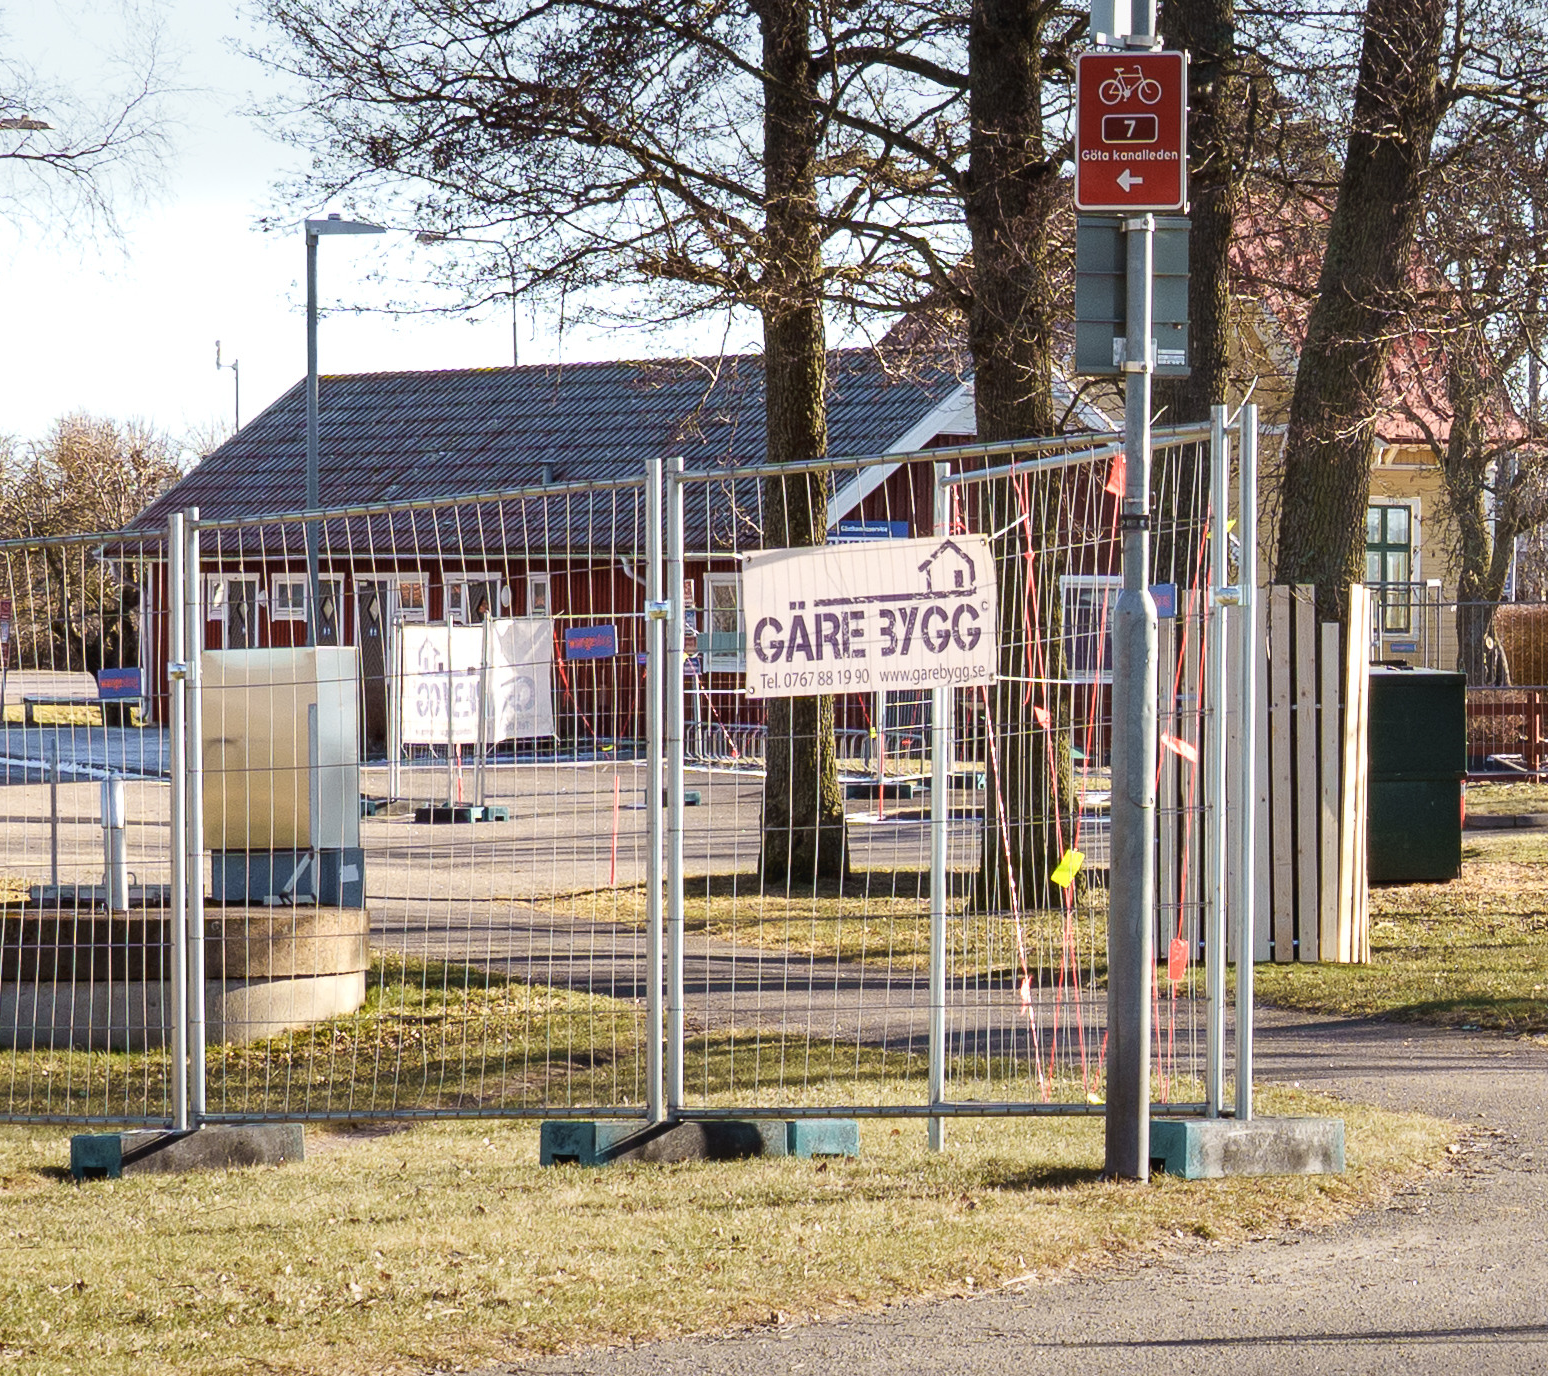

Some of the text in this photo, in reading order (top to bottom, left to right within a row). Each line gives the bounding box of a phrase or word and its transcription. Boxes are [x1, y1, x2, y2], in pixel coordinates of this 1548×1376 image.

[1123, 119, 1137, 138] 7
[1081, 149, 1179, 161] Göta kanalleden
[753, 600, 867, 664] GÄRE
[879, 603, 982, 659] BYGG
[760, 662, 986, 689] Tel. 0767 88 19 90 www.garebygg.se
